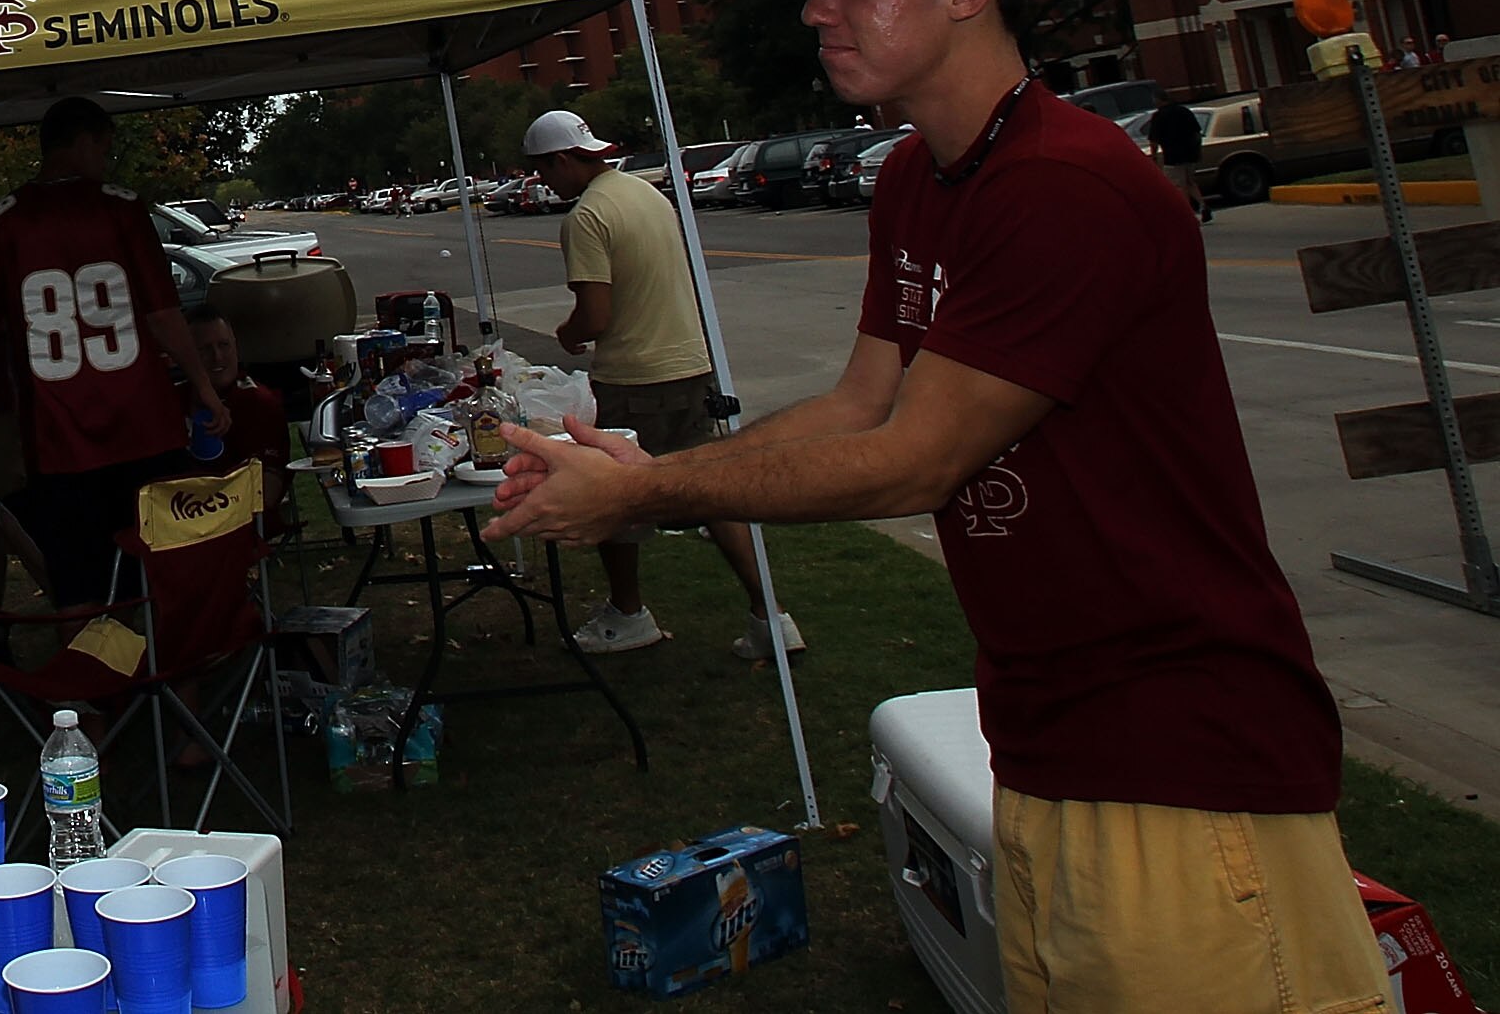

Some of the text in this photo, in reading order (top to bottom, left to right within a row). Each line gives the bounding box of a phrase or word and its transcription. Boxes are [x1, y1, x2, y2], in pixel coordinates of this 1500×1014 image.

[20, 260, 141, 382] 89
[1435, 951, 1463, 998] 20 CANS
